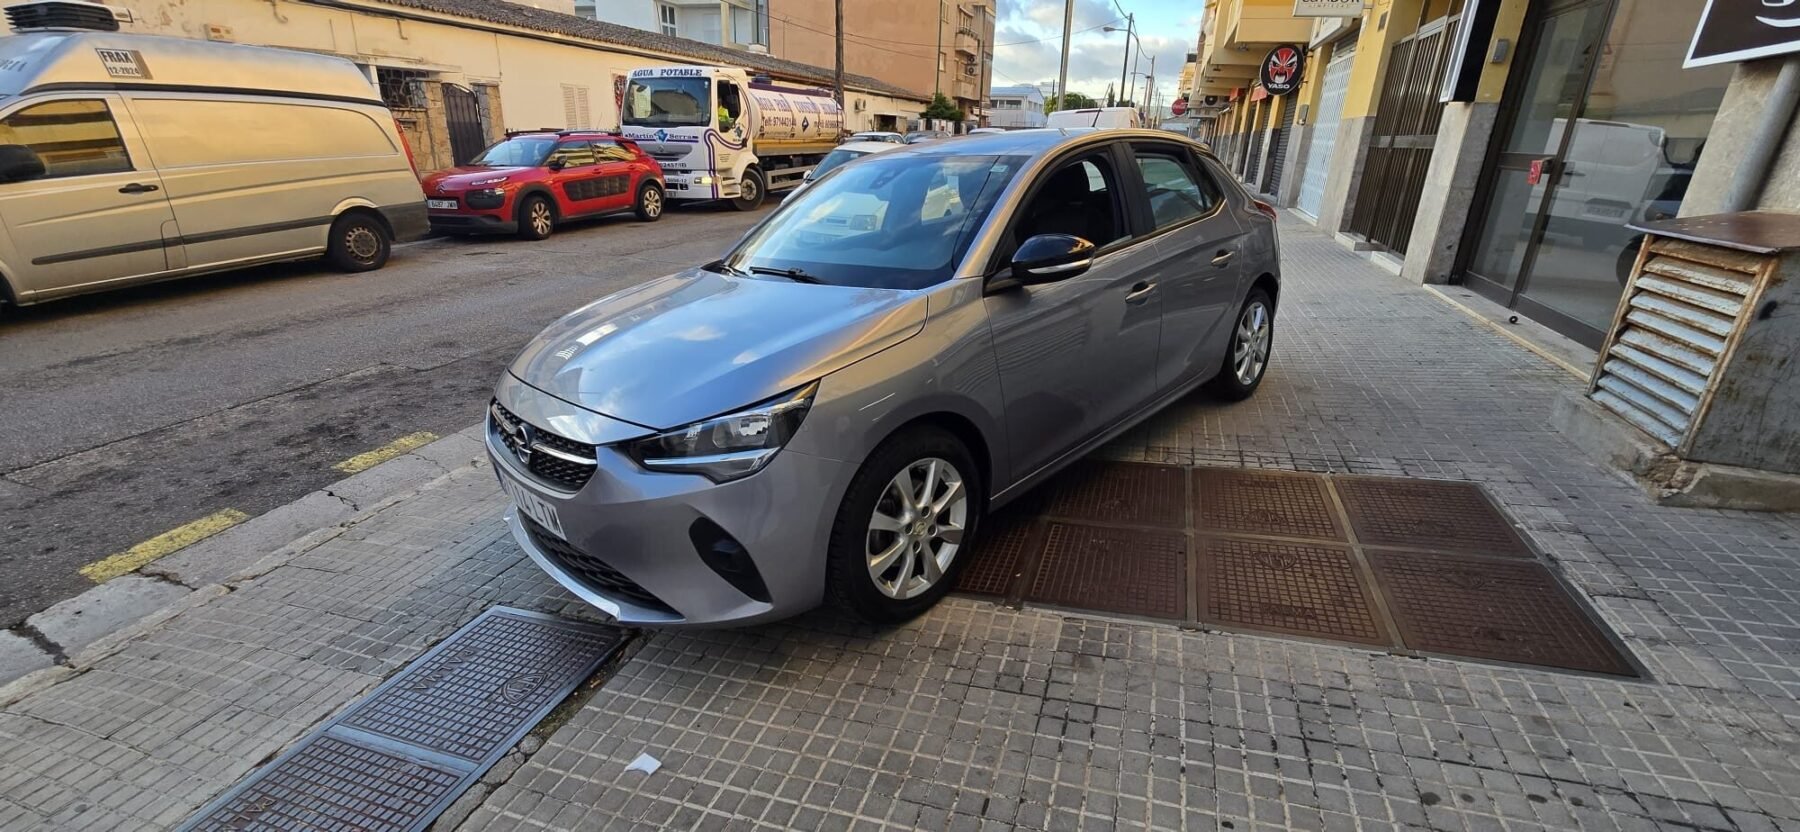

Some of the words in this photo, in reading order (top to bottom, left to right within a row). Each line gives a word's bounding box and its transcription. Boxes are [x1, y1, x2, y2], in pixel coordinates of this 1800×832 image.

[100, 50, 133, 64] FRAX
[108, 66, 140, 75] 12-2024
[632, 69, 654, 77] AGUA
[660, 68, 702, 77] POTABLE
